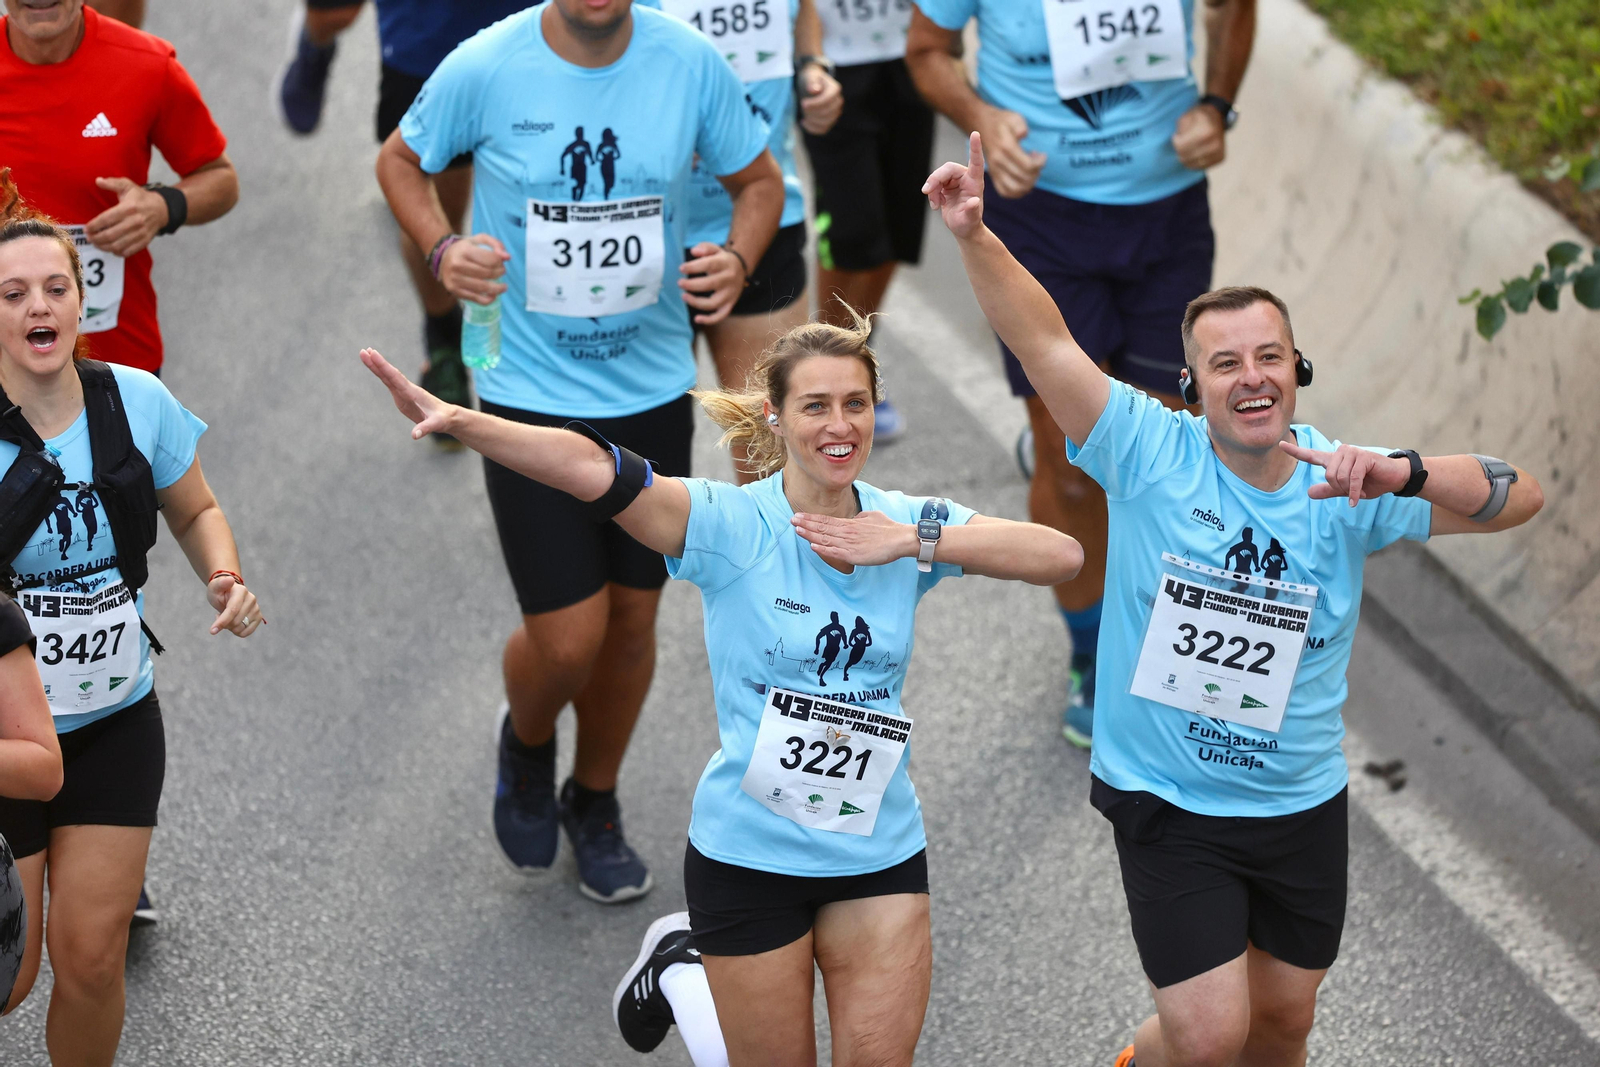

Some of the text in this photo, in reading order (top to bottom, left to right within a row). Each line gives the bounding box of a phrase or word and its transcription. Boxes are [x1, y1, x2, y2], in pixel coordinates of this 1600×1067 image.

[690, 0, 771, 37] 1585
[1075, 5, 1163, 45] 1542
[82, 127, 118, 138] adidas
[533, 203, 568, 223] 43
[553, 235, 642, 269] 3120
[557, 324, 640, 342] Fundación
[570, 345, 627, 361] Unicaja
[23, 594, 61, 618] 43
[62, 607, 93, 616] CIUDAD
[1164, 579, 1309, 621] 43 CARRERA URBANA
[1203, 601, 1238, 616] CIUDAD
[41, 622, 126, 665] 3427
[1172, 623, 1276, 676] 3222
[772, 692, 912, 732] 43 CARRERA URBANA
[811, 712, 844, 726] CIUDAD
[1189, 721, 1278, 749] Fundación
[780, 736, 873, 781] 3221
[1198, 747, 1264, 770] Unicaja
